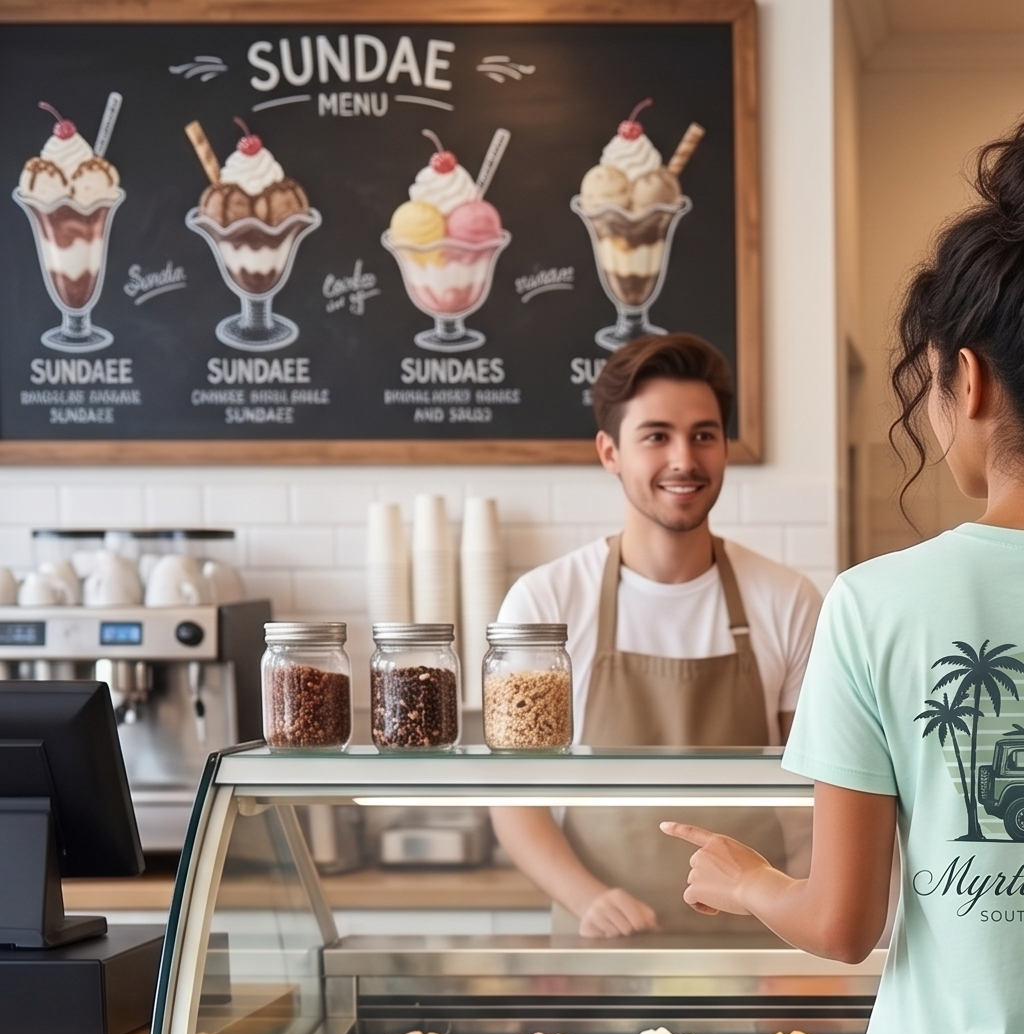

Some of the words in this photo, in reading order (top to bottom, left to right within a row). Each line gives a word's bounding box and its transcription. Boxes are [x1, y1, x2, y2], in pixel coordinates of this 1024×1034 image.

[247, 34, 456, 91] SUNDAE
[318, 92, 389, 117] MENU
[30, 357, 134, 385] SUNDAEE
[206, 357, 311, 385] SUNDAEE
[400, 357, 505, 385] SUNDAES
